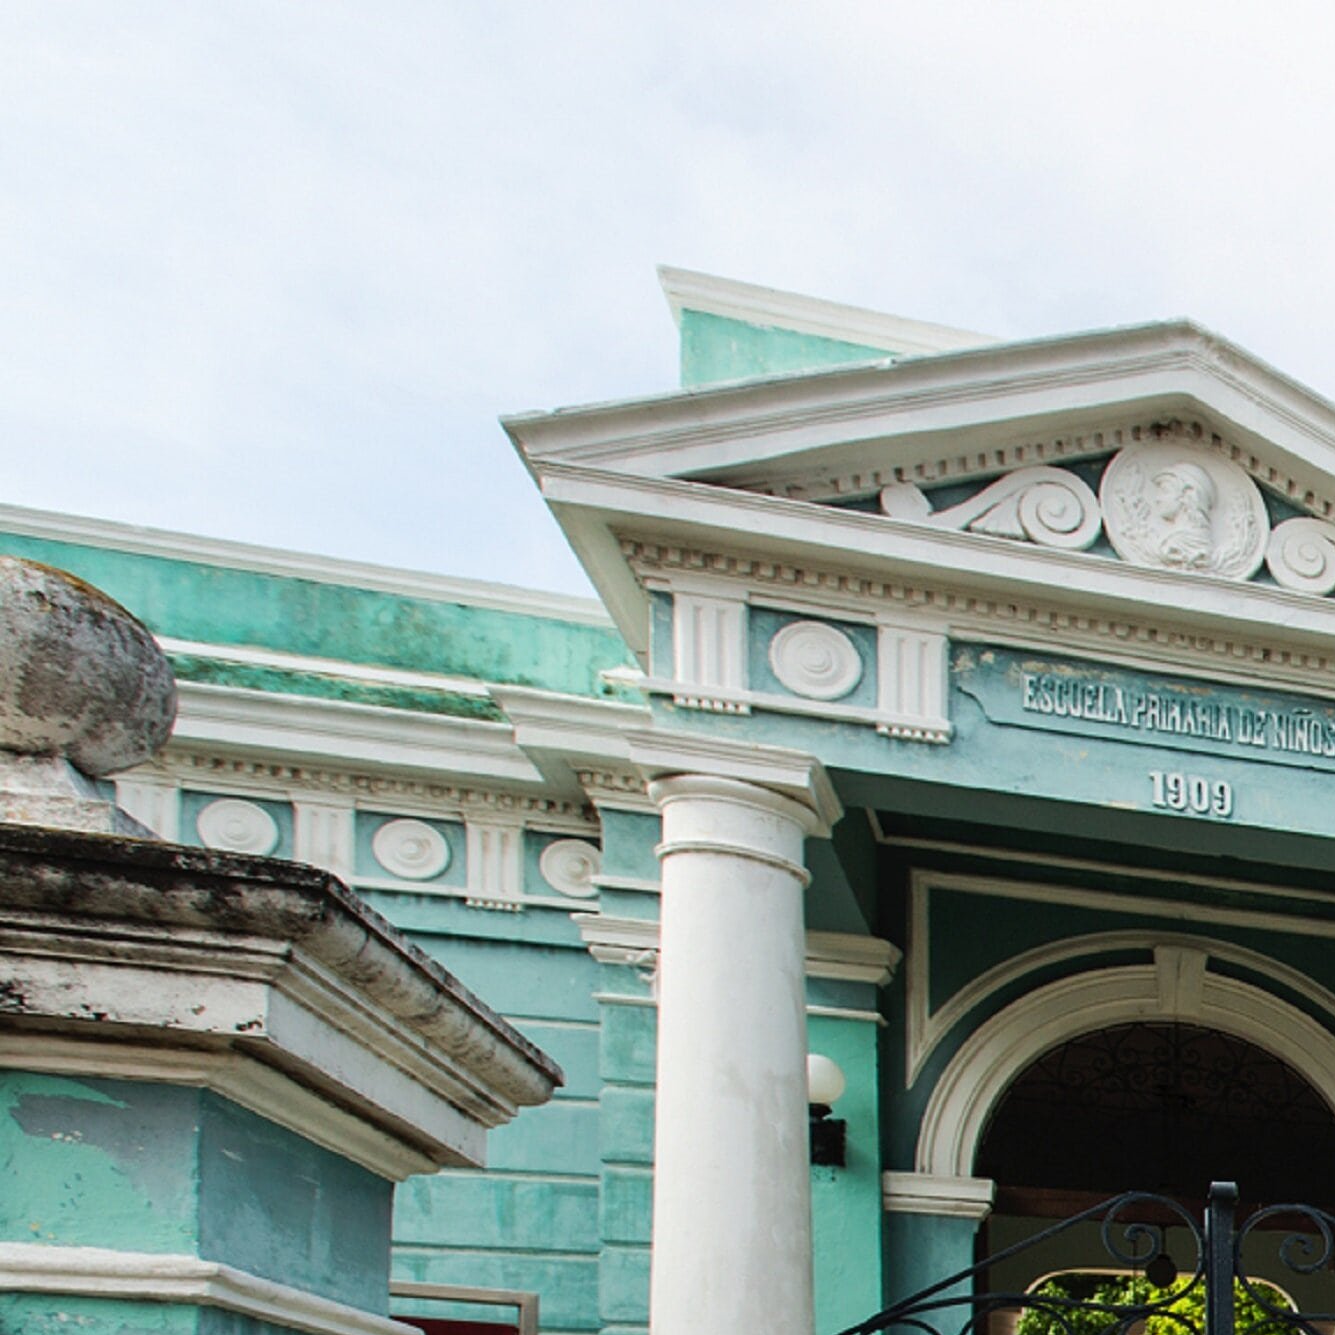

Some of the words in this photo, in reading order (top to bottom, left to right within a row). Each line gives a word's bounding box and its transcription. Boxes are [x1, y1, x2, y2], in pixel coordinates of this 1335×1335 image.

[1022, 674, 1128, 725] ESCUELA
[1130, 693, 1232, 742] PRIMARIA
[1238, 709, 1267, 747] DE
[1148, 771, 1232, 817] 1909
